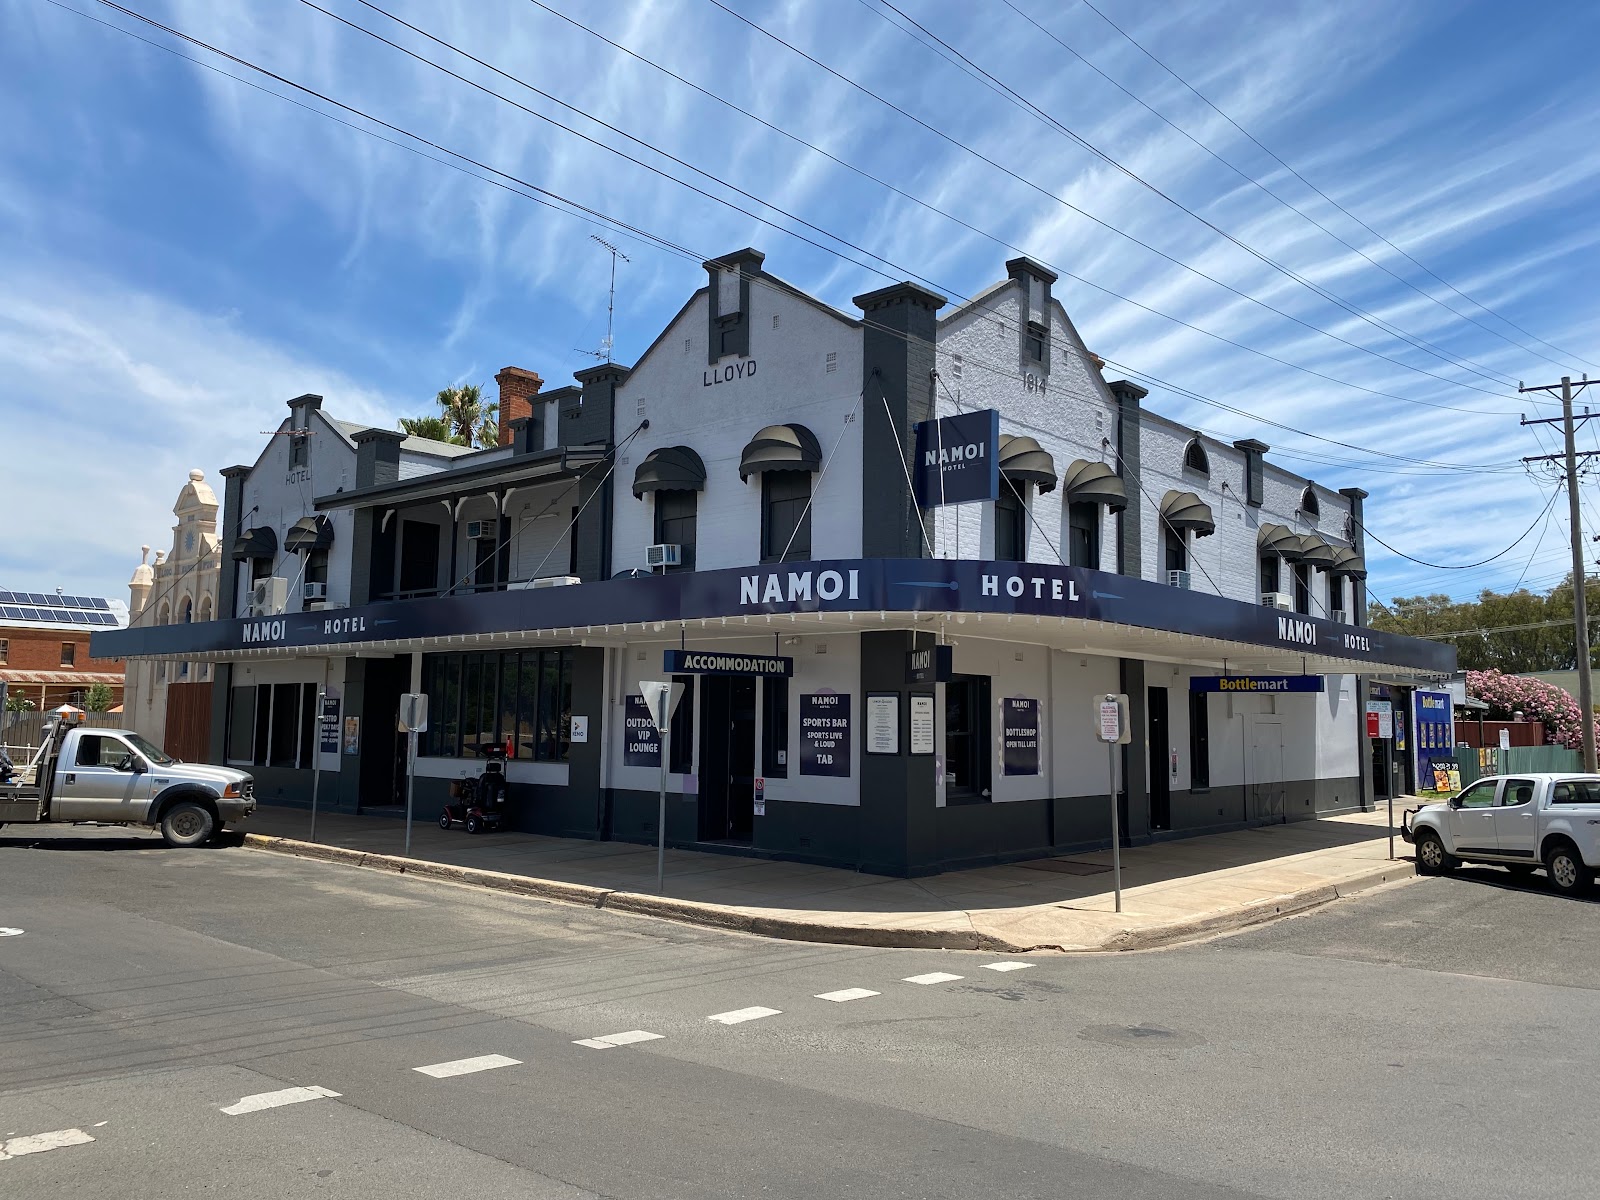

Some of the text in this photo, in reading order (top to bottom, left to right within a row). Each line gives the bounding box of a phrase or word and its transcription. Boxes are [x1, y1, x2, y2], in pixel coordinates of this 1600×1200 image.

[703, 360, 757, 387] LLOYD
[1023, 371, 1047, 395] 1914
[925, 442, 985, 466] NAMOI
[943, 463, 966, 471] HOTEL
[285, 470, 311, 486] HOTEL
[740, 570, 1079, 605] NAMOI HOTEL
[243, 617, 366, 642] NAMOI HOTEL
[1278, 617, 1370, 652] NAMOI HOTEL
[684, 655, 785, 673] ACCOMMODATION
[911, 650, 930, 670] NAMOI
[1219, 678, 1289, 690] Bottlemart
[811, 696, 839, 705] NAMOI
[1012, 700, 1030, 708] NAMOI
[803, 718, 848, 727] SPORTS BAR
[638, 730, 651, 740] VIP
[807, 731, 843, 740] SPORTS LIVE
[1005, 728, 1037, 737] BOTTLESHOP
[629, 742, 659, 753] LOUNGE
[814, 740, 836, 748] & LOUD
[816, 754, 834, 765] TAB
